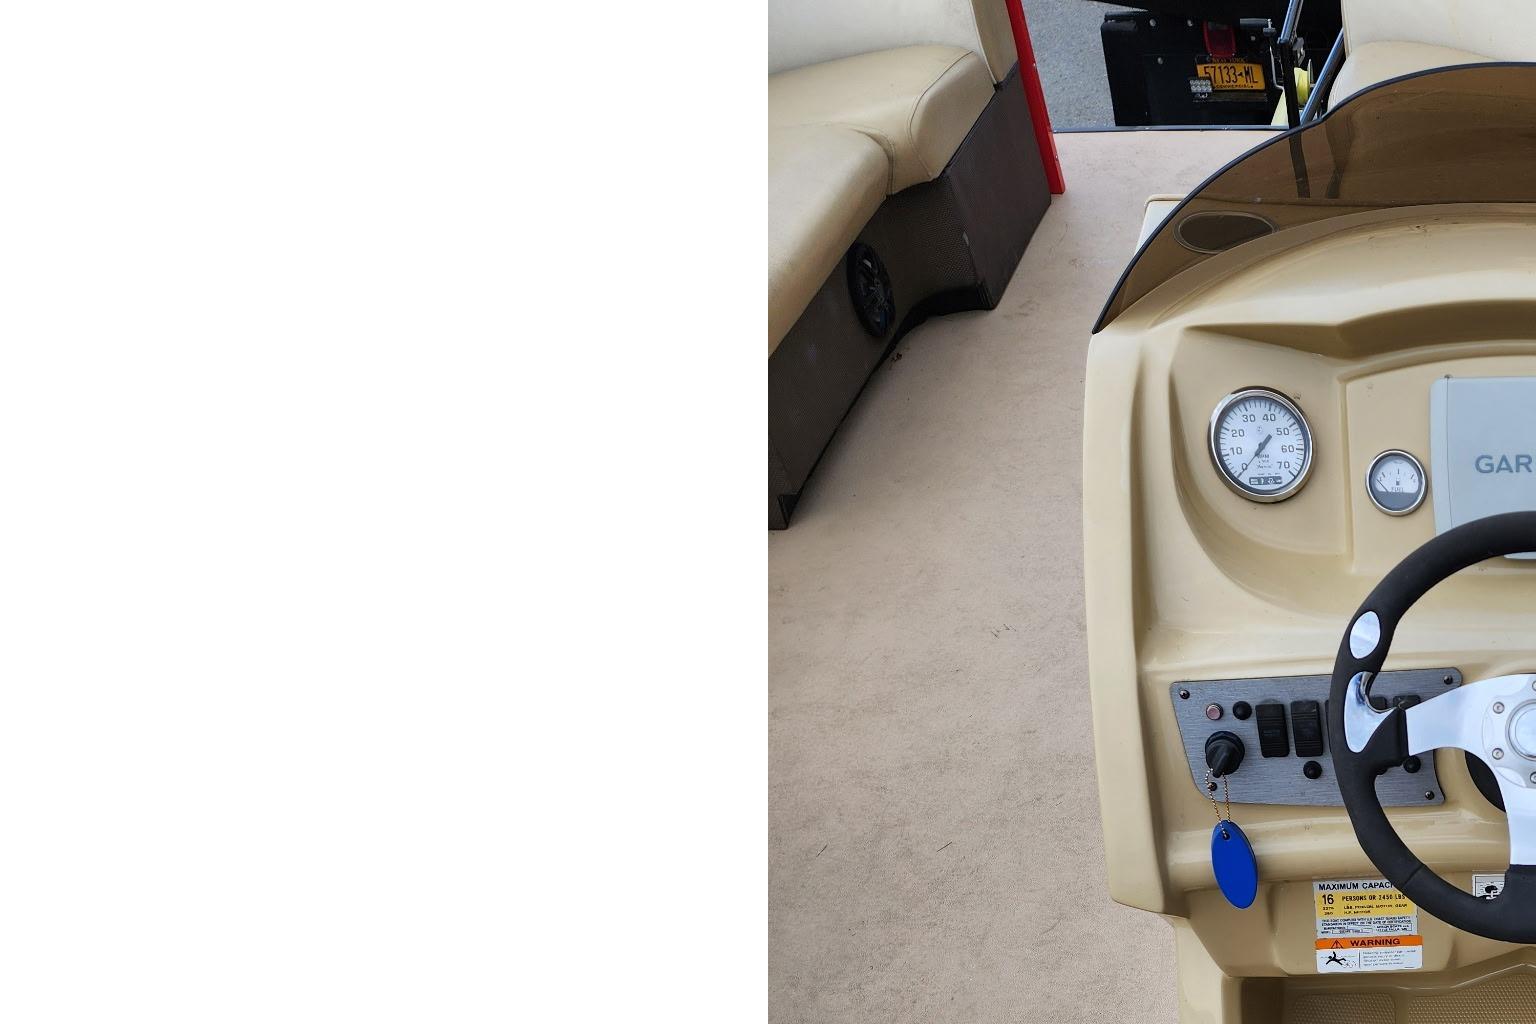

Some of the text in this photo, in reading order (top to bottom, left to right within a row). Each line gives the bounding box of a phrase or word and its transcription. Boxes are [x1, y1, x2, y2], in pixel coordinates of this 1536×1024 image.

[1242, 414, 1256, 423] 30
[1262, 413, 1276, 422] 40
[1231, 428, 1245, 438] 20
[1276, 427, 1290, 436] 50
[1229, 446, 1243, 455] 10
[1281, 444, 1295, 453] 60
[1277, 460, 1290, 469] 70
[1318, 881, 1393, 890] MAXIMUM CAPACI
[1321, 893, 1334, 905] 16
[1350, 938, 1401, 947] WARNING
